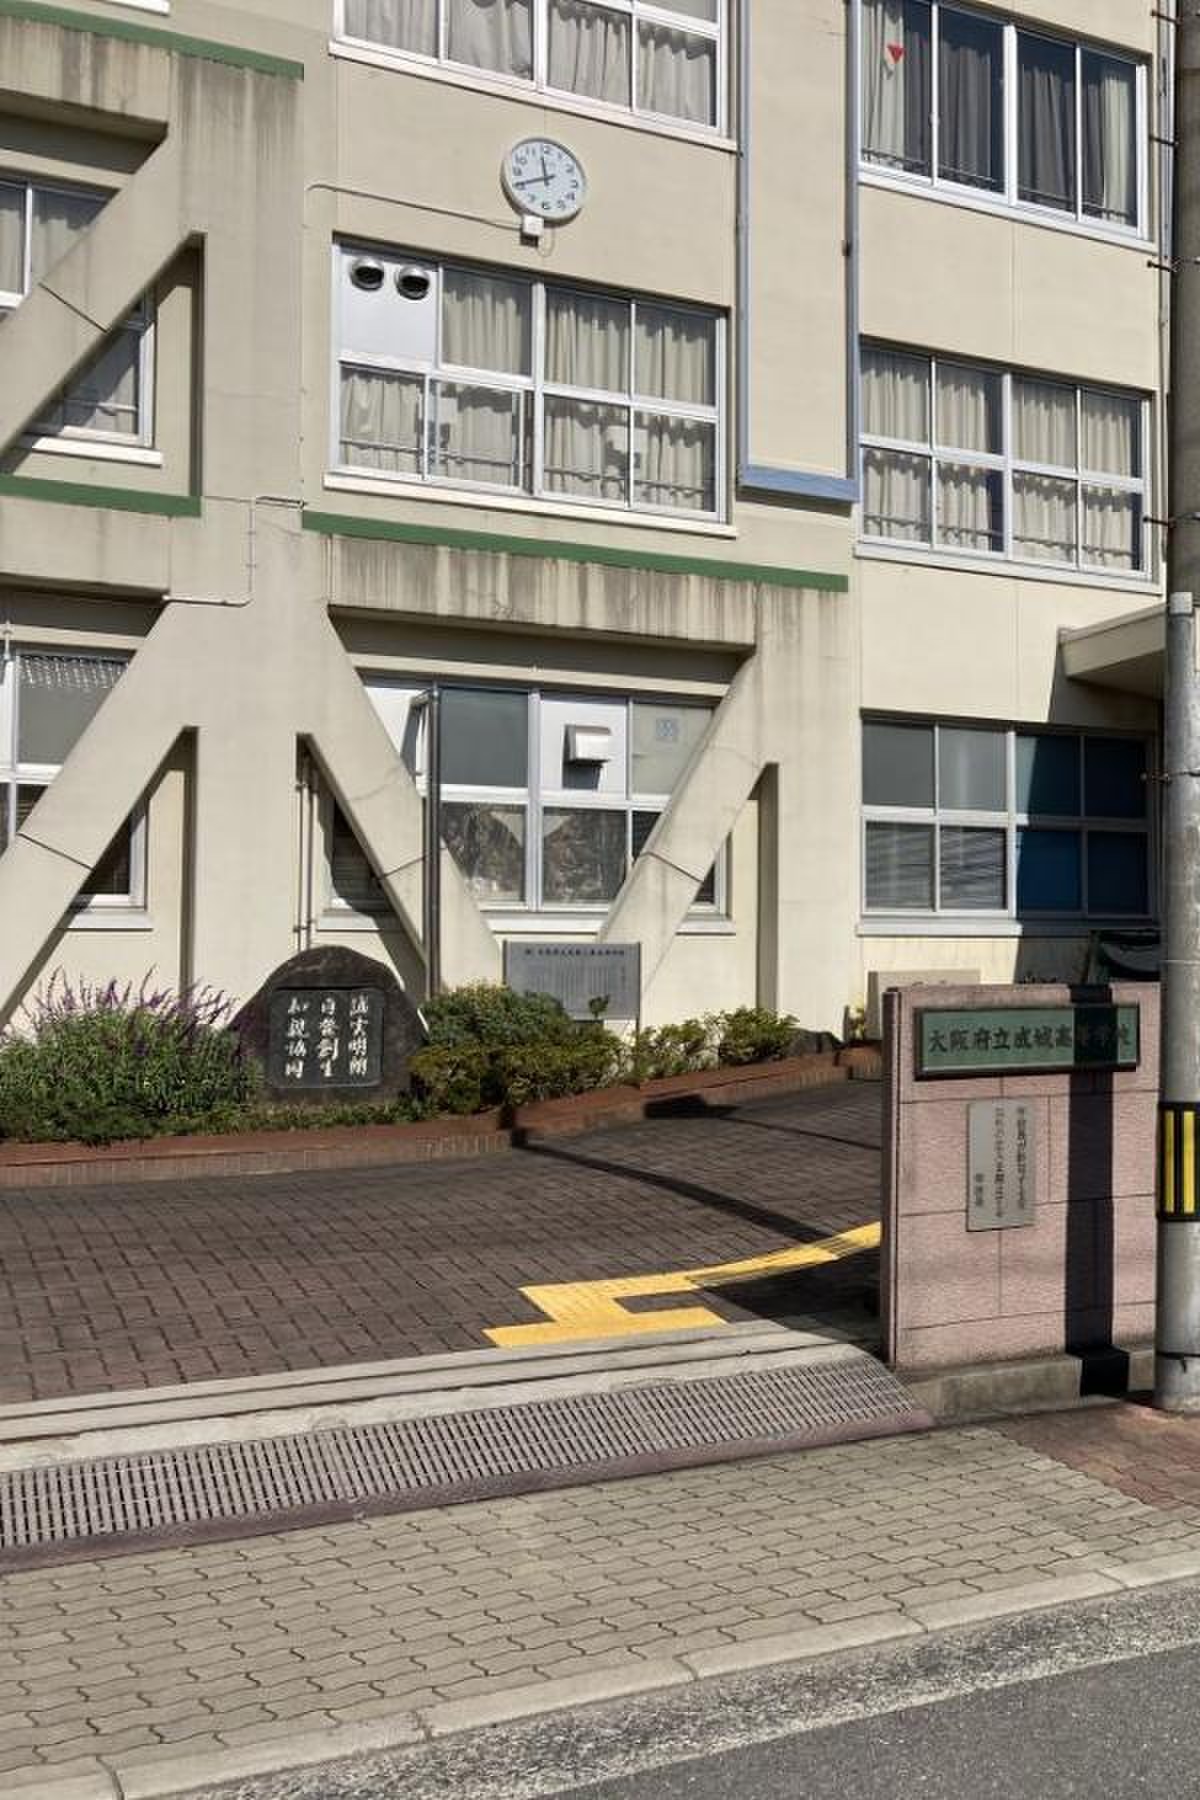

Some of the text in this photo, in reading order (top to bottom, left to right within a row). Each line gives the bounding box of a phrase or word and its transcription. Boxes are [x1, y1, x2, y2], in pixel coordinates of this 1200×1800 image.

[927, 1022, 1132, 1054] 大阪府立成城高校
